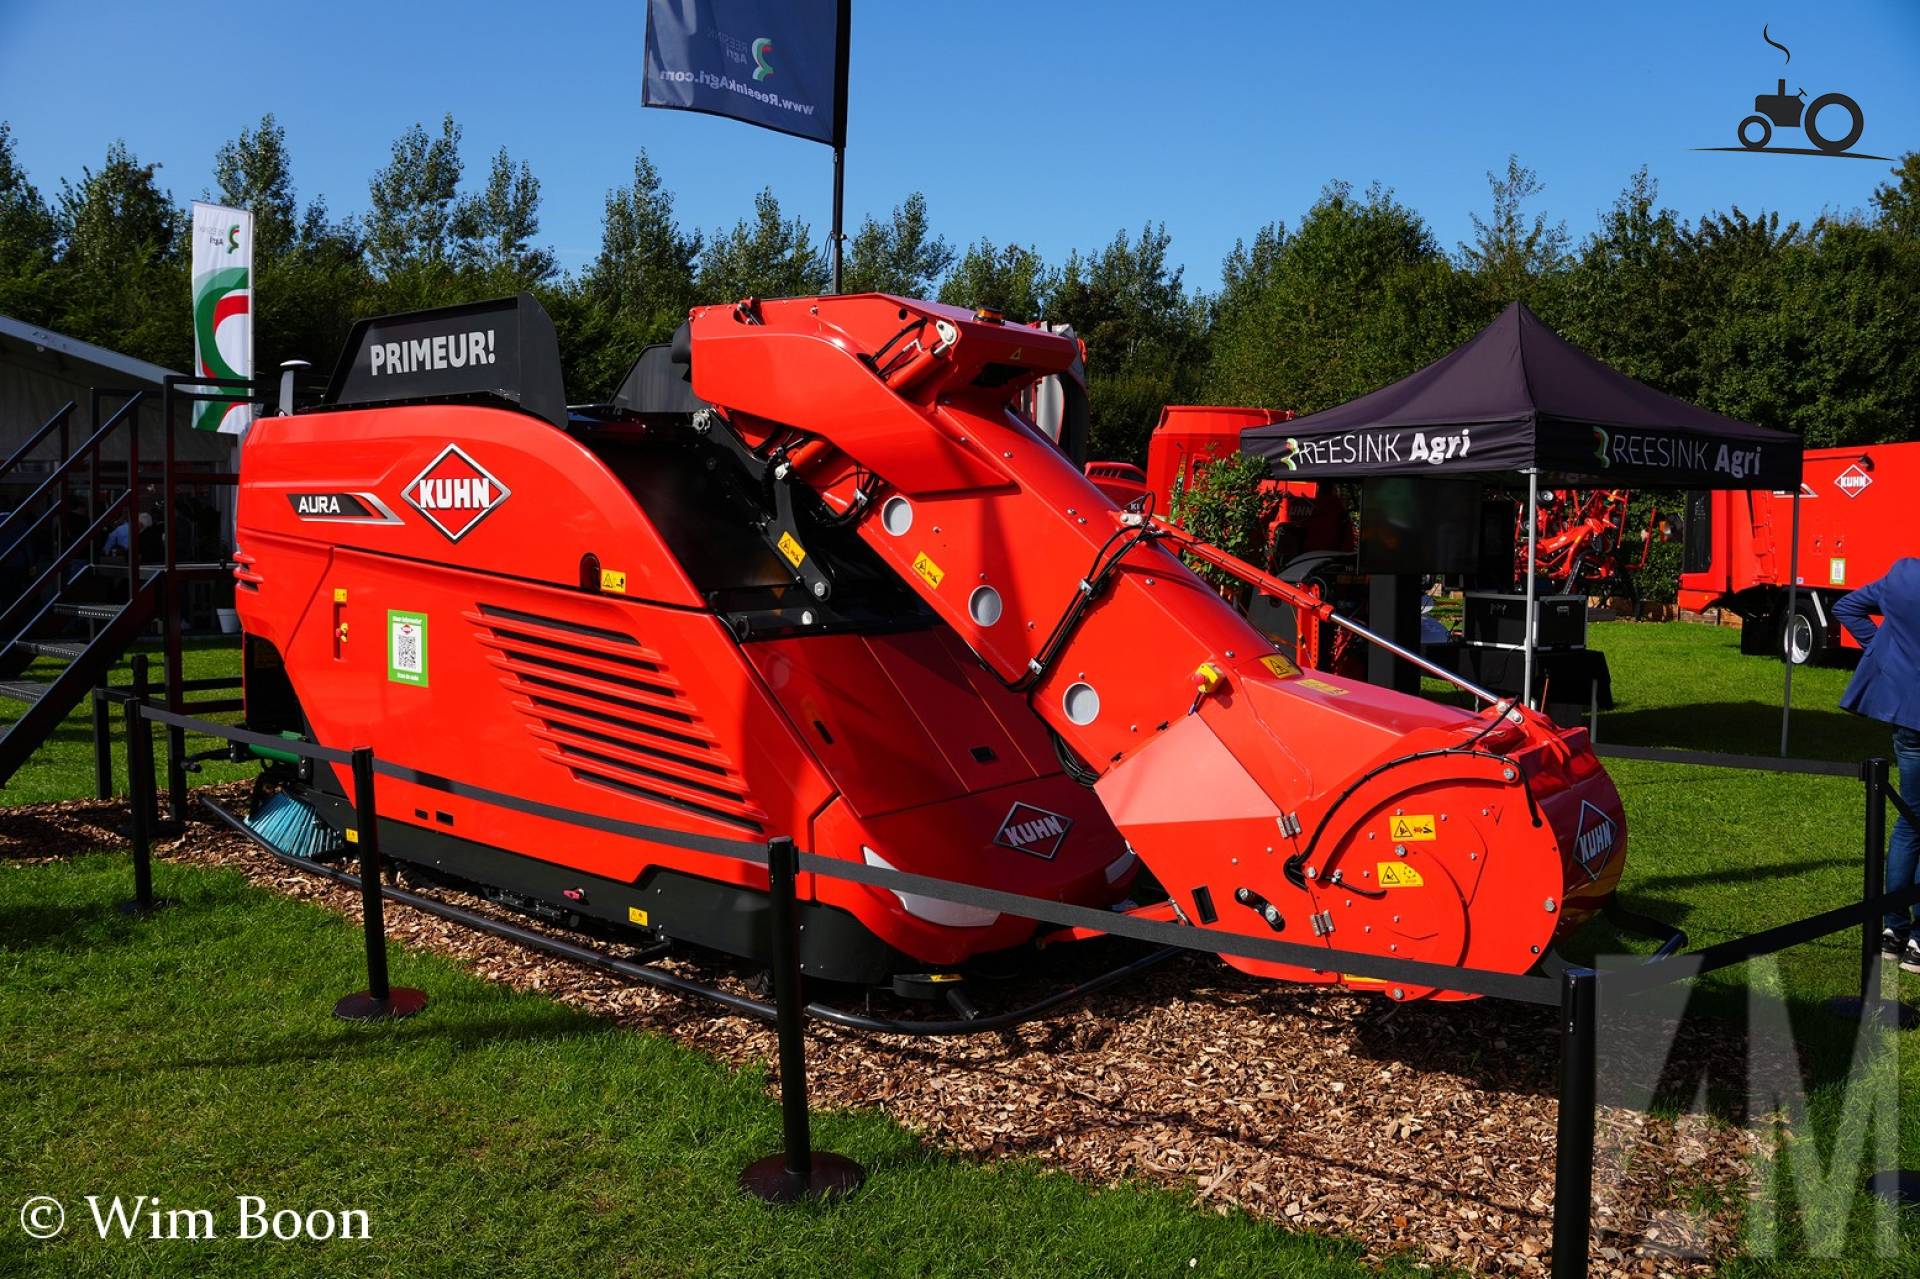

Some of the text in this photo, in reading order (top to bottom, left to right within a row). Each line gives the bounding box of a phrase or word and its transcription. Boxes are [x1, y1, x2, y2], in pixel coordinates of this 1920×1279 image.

[370, 329, 496, 376] PRIMEUR!
[1300, 428, 1471, 465] REESINK Agri
[1613, 434, 1762, 479] REESINK Agri
[419, 478, 491, 510] KUHN
[1840, 475, 1867, 488] KUHN
[298, 496, 341, 514] AURA
[1004, 815, 1064, 847] KUHN
[1579, 820, 1612, 863] KUHN
